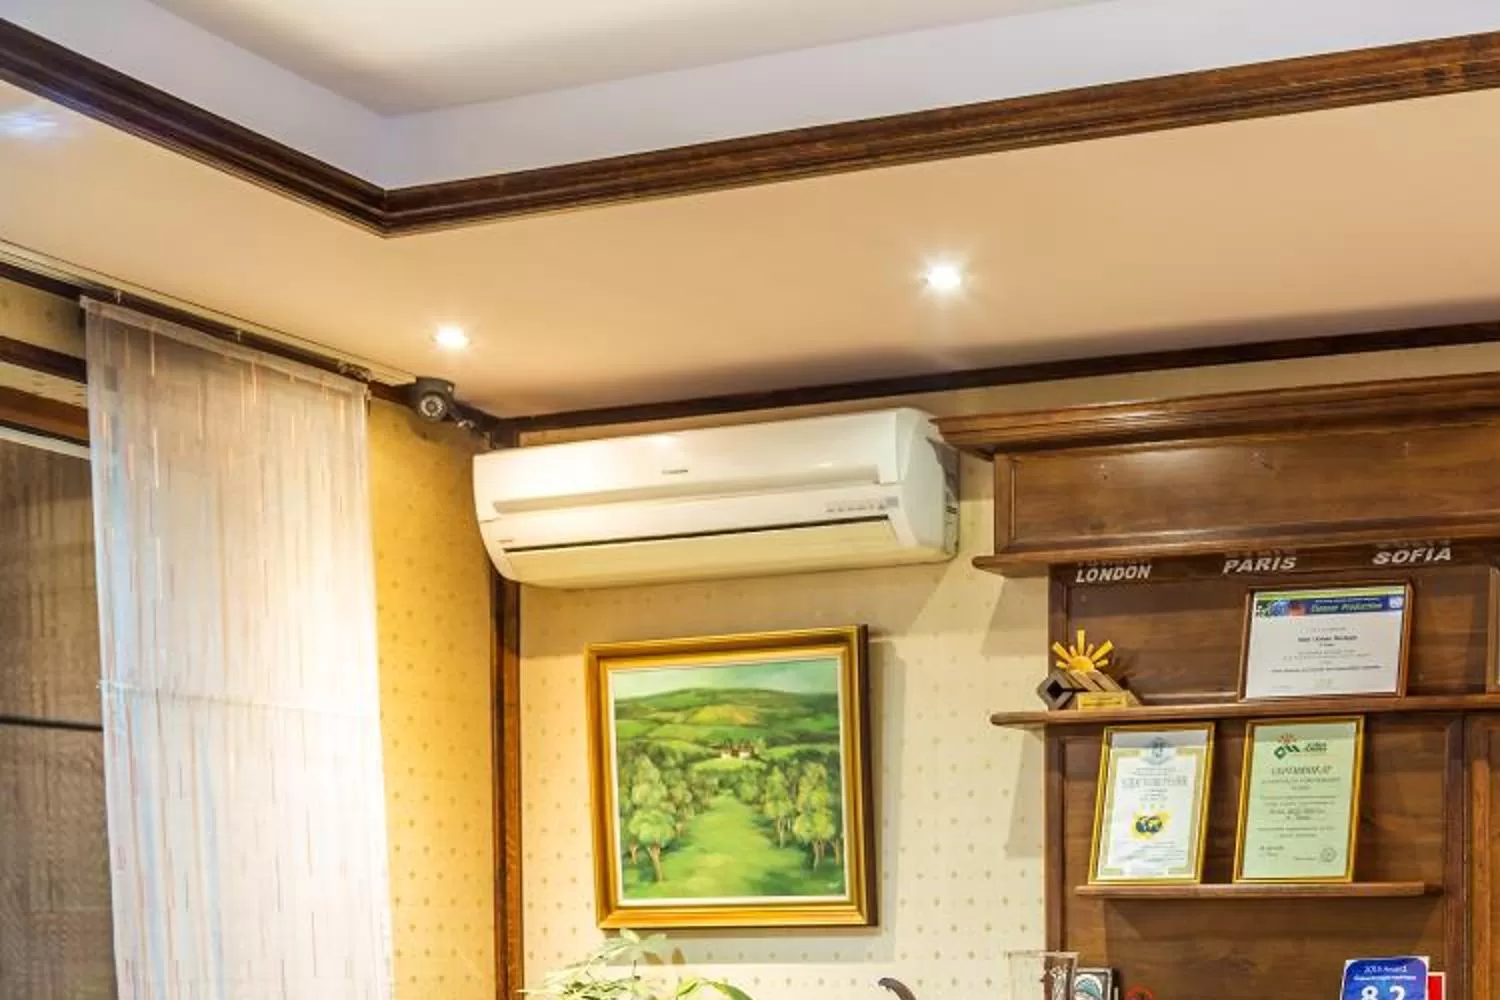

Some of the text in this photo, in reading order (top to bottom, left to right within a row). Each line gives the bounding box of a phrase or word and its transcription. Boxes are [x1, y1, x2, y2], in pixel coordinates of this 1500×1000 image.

[1222, 556, 1297, 575] PARIS
[1371, 548, 1453, 566] SOFIA
[1075, 564, 1152, 583] LONDON
